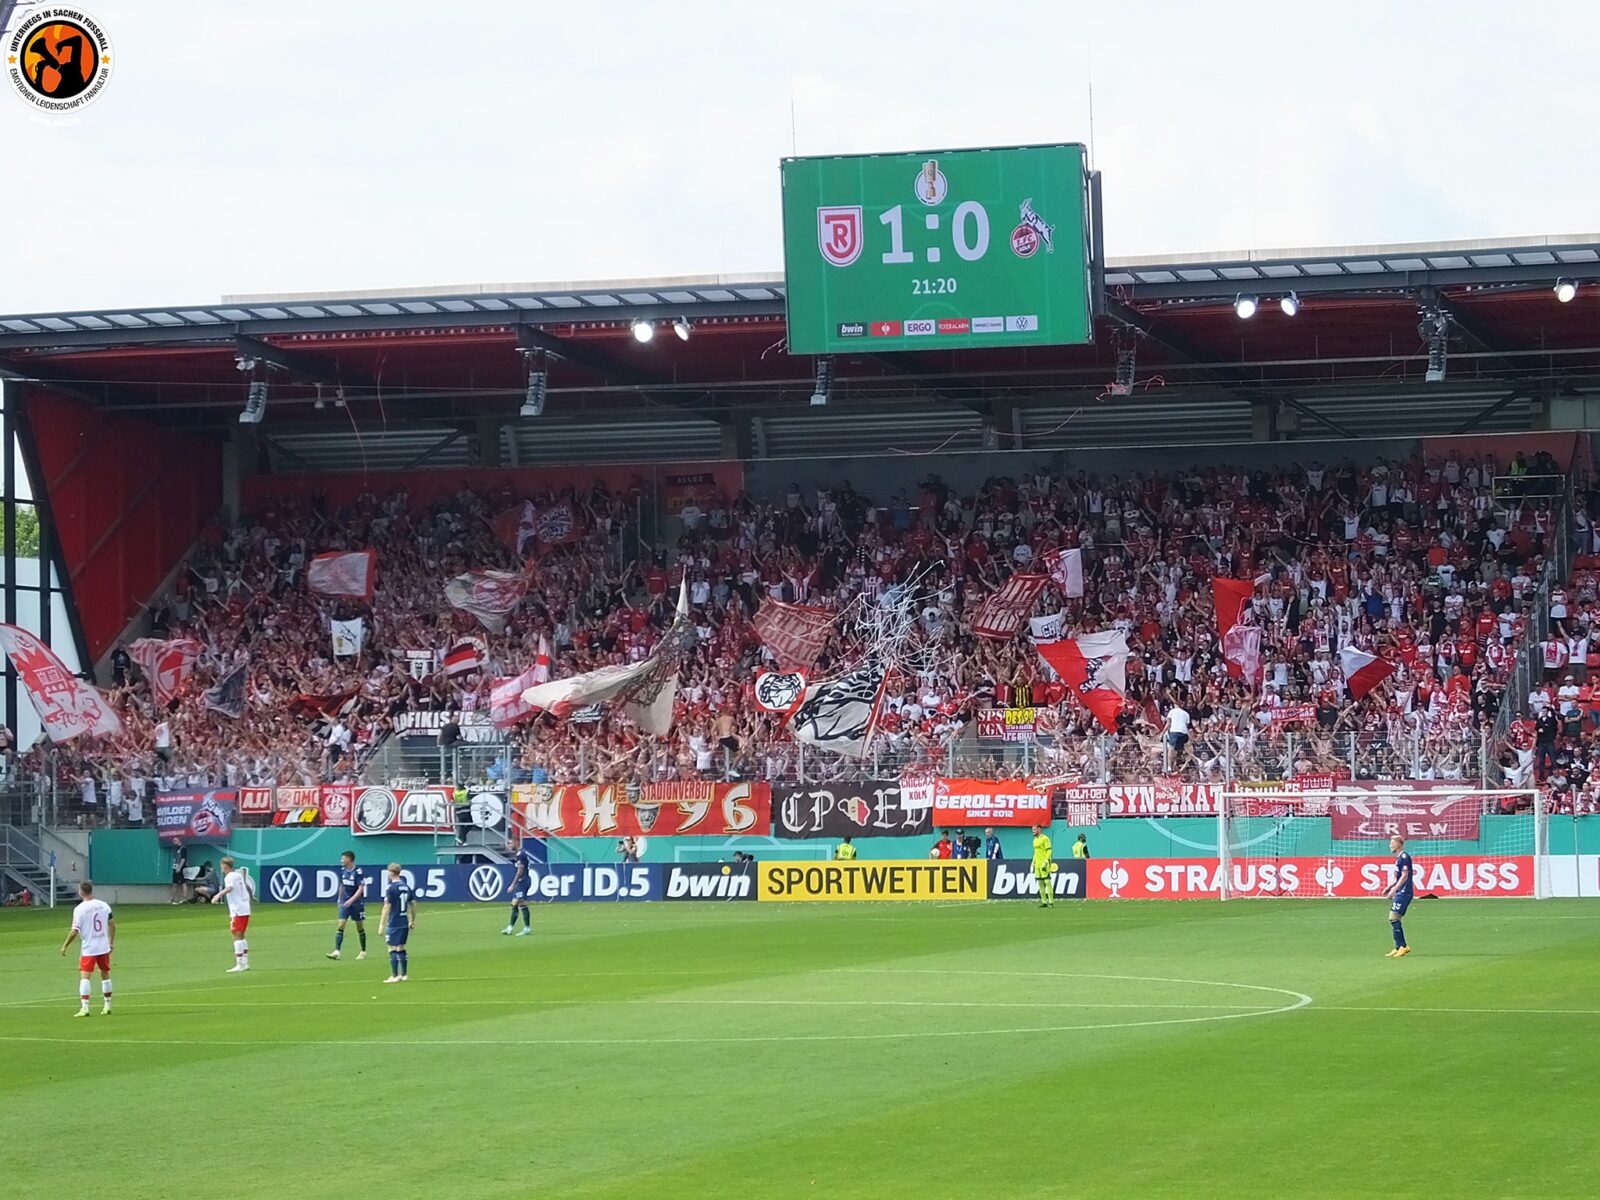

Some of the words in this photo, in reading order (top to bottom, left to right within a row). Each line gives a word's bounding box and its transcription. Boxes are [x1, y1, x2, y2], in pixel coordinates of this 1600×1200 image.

[912, 278, 957, 295] 21:20
[841, 323, 864, 334] bwin
[907, 322, 932, 333] ERGO
[978, 710, 1003, 722] SPS
[640, 781, 712, 801] STADIONVERBOT
[156, 805, 192, 816] WILDER
[935, 794, 1048, 810] GEROLSTEIN
[966, 809, 990, 818] SINCE
[992, 809, 1014, 818] 2012
[1357, 821, 1448, 836] CREW
[583, 867, 650, 898] ID.5
[666, 865, 751, 898] bwin
[767, 865, 978, 895] SPORTWETTEN
[1144, 864, 1299, 892] STRAUSS
[1360, 862, 1520, 891] STRAUSS
[93, 912, 102, 933] 6
